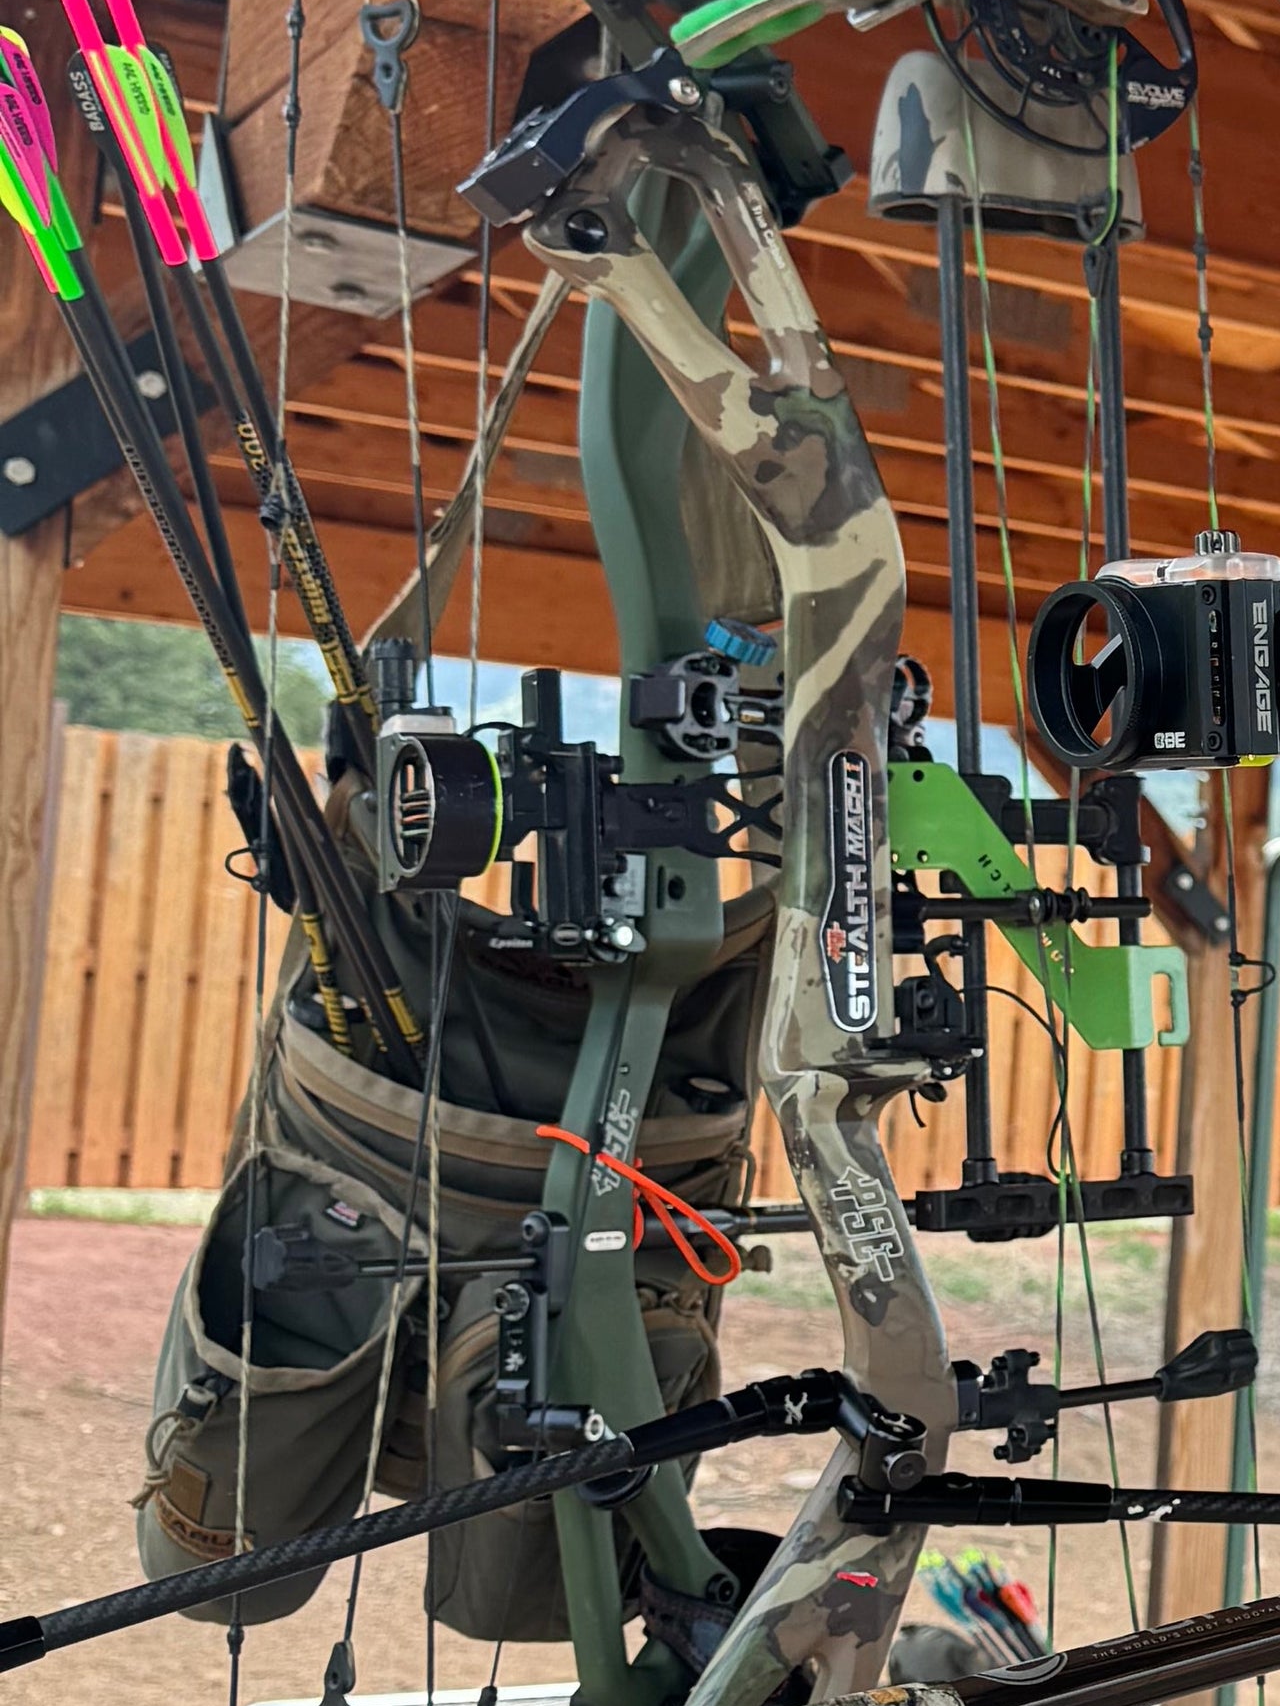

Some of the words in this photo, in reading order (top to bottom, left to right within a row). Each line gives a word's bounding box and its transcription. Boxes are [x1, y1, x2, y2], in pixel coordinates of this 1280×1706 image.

[70, 71, 104, 131] BADASS
[1127, 81, 1186, 102] EVOLVE
[1252, 598, 1273, 735] ENGAGE
[1154, 731, 1186, 749] CBE
[844, 779, 866, 861] MACH
[846, 863, 870, 1020] STEALTH
[830, 1165, 905, 1283] PSE
[1092, 1649, 1118, 1661] THE
